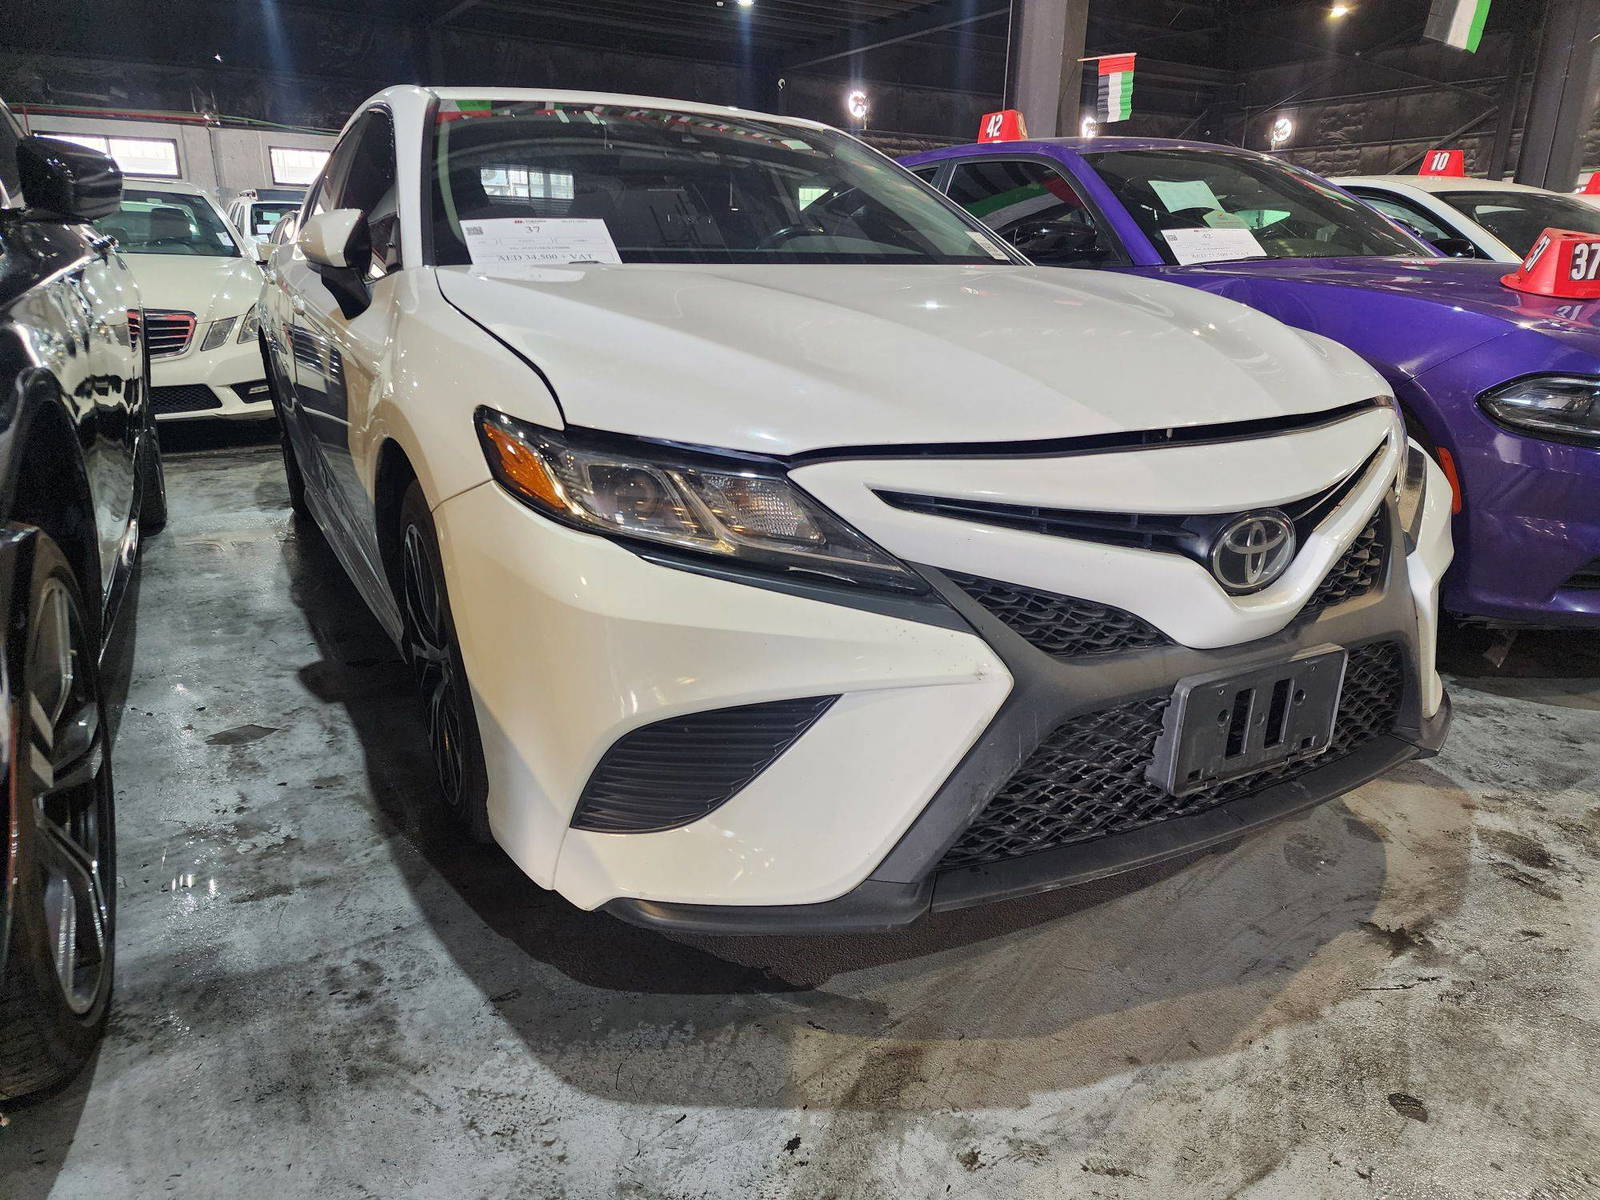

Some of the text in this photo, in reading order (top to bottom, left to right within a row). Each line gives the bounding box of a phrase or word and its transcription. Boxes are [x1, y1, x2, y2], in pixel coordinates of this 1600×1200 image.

[986, 114, 1003, 138] 42
[1431, 152, 1450, 171] 10
[1572, 243, 1600, 280] 37
